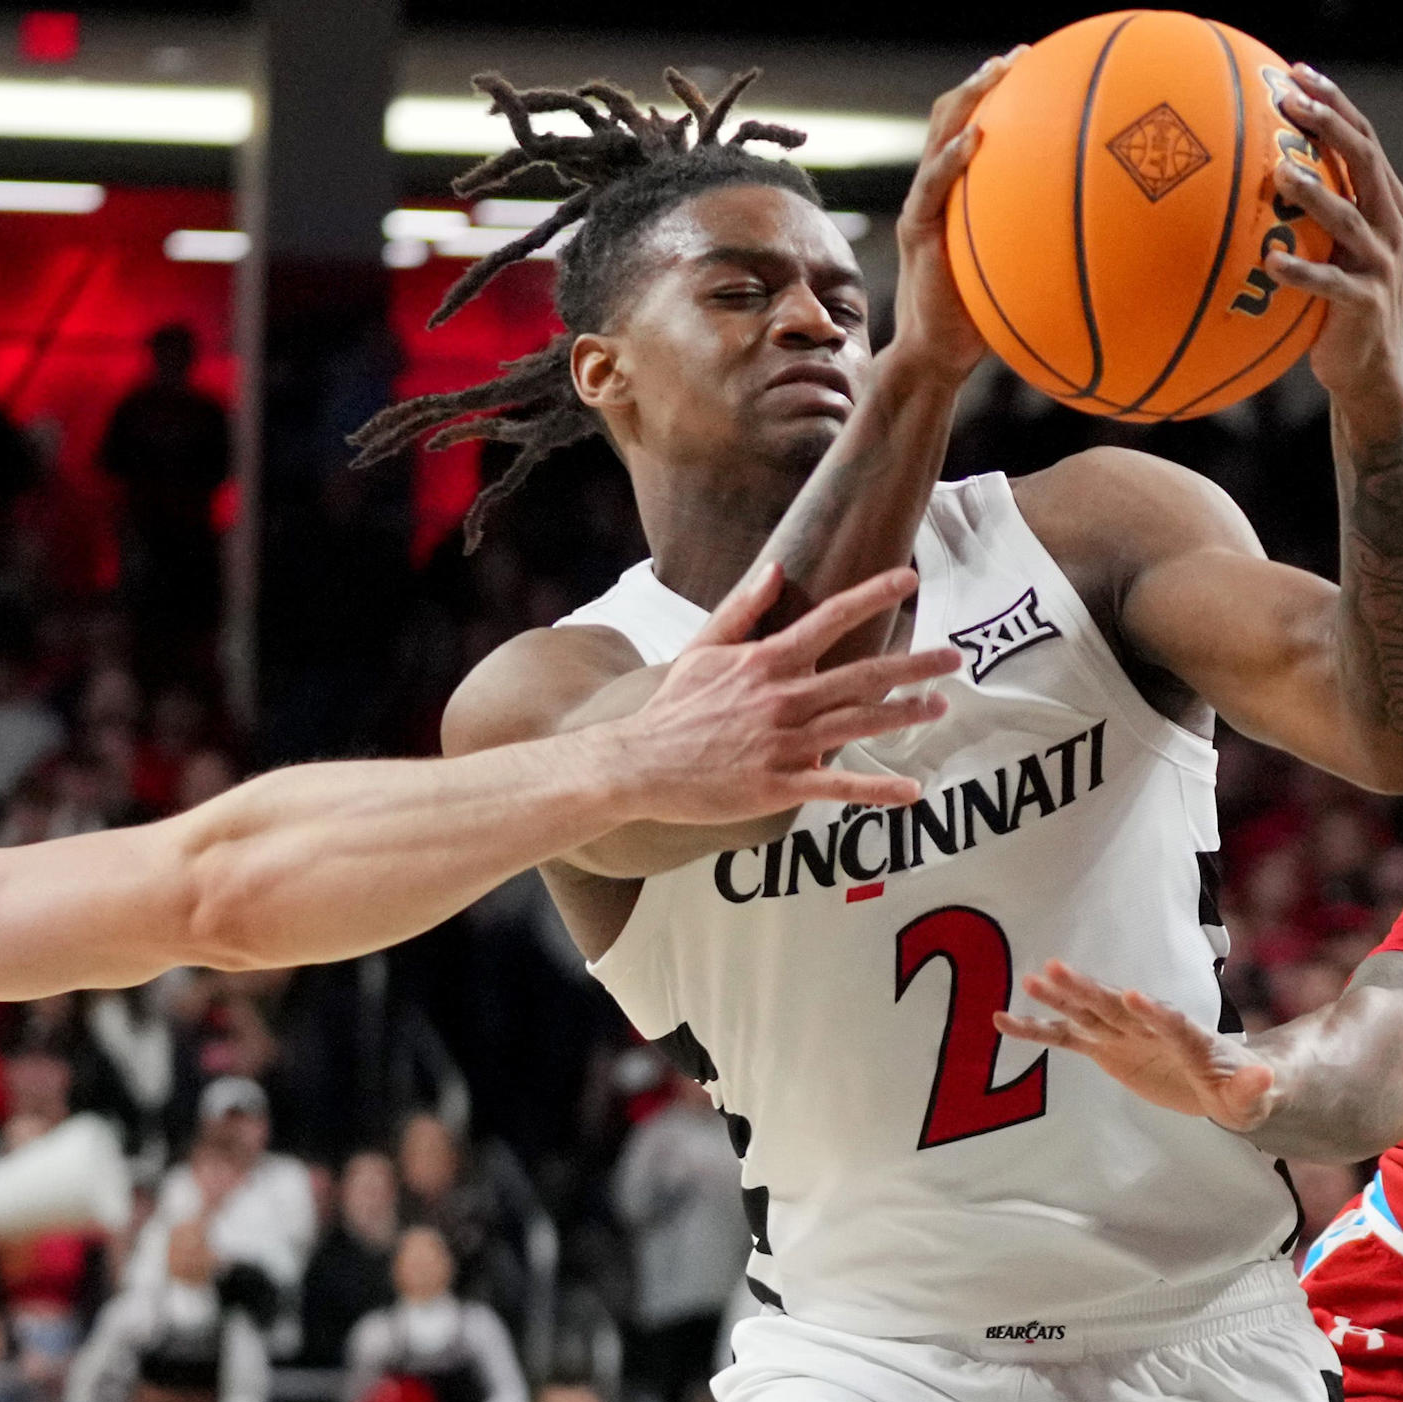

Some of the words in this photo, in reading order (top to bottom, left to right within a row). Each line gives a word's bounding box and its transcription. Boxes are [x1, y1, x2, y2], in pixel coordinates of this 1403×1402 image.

[714, 719, 1107, 903] CINCINNATI
[896, 905, 1048, 1151] 2
[986, 1321, 1066, 1340] BEARCATS
